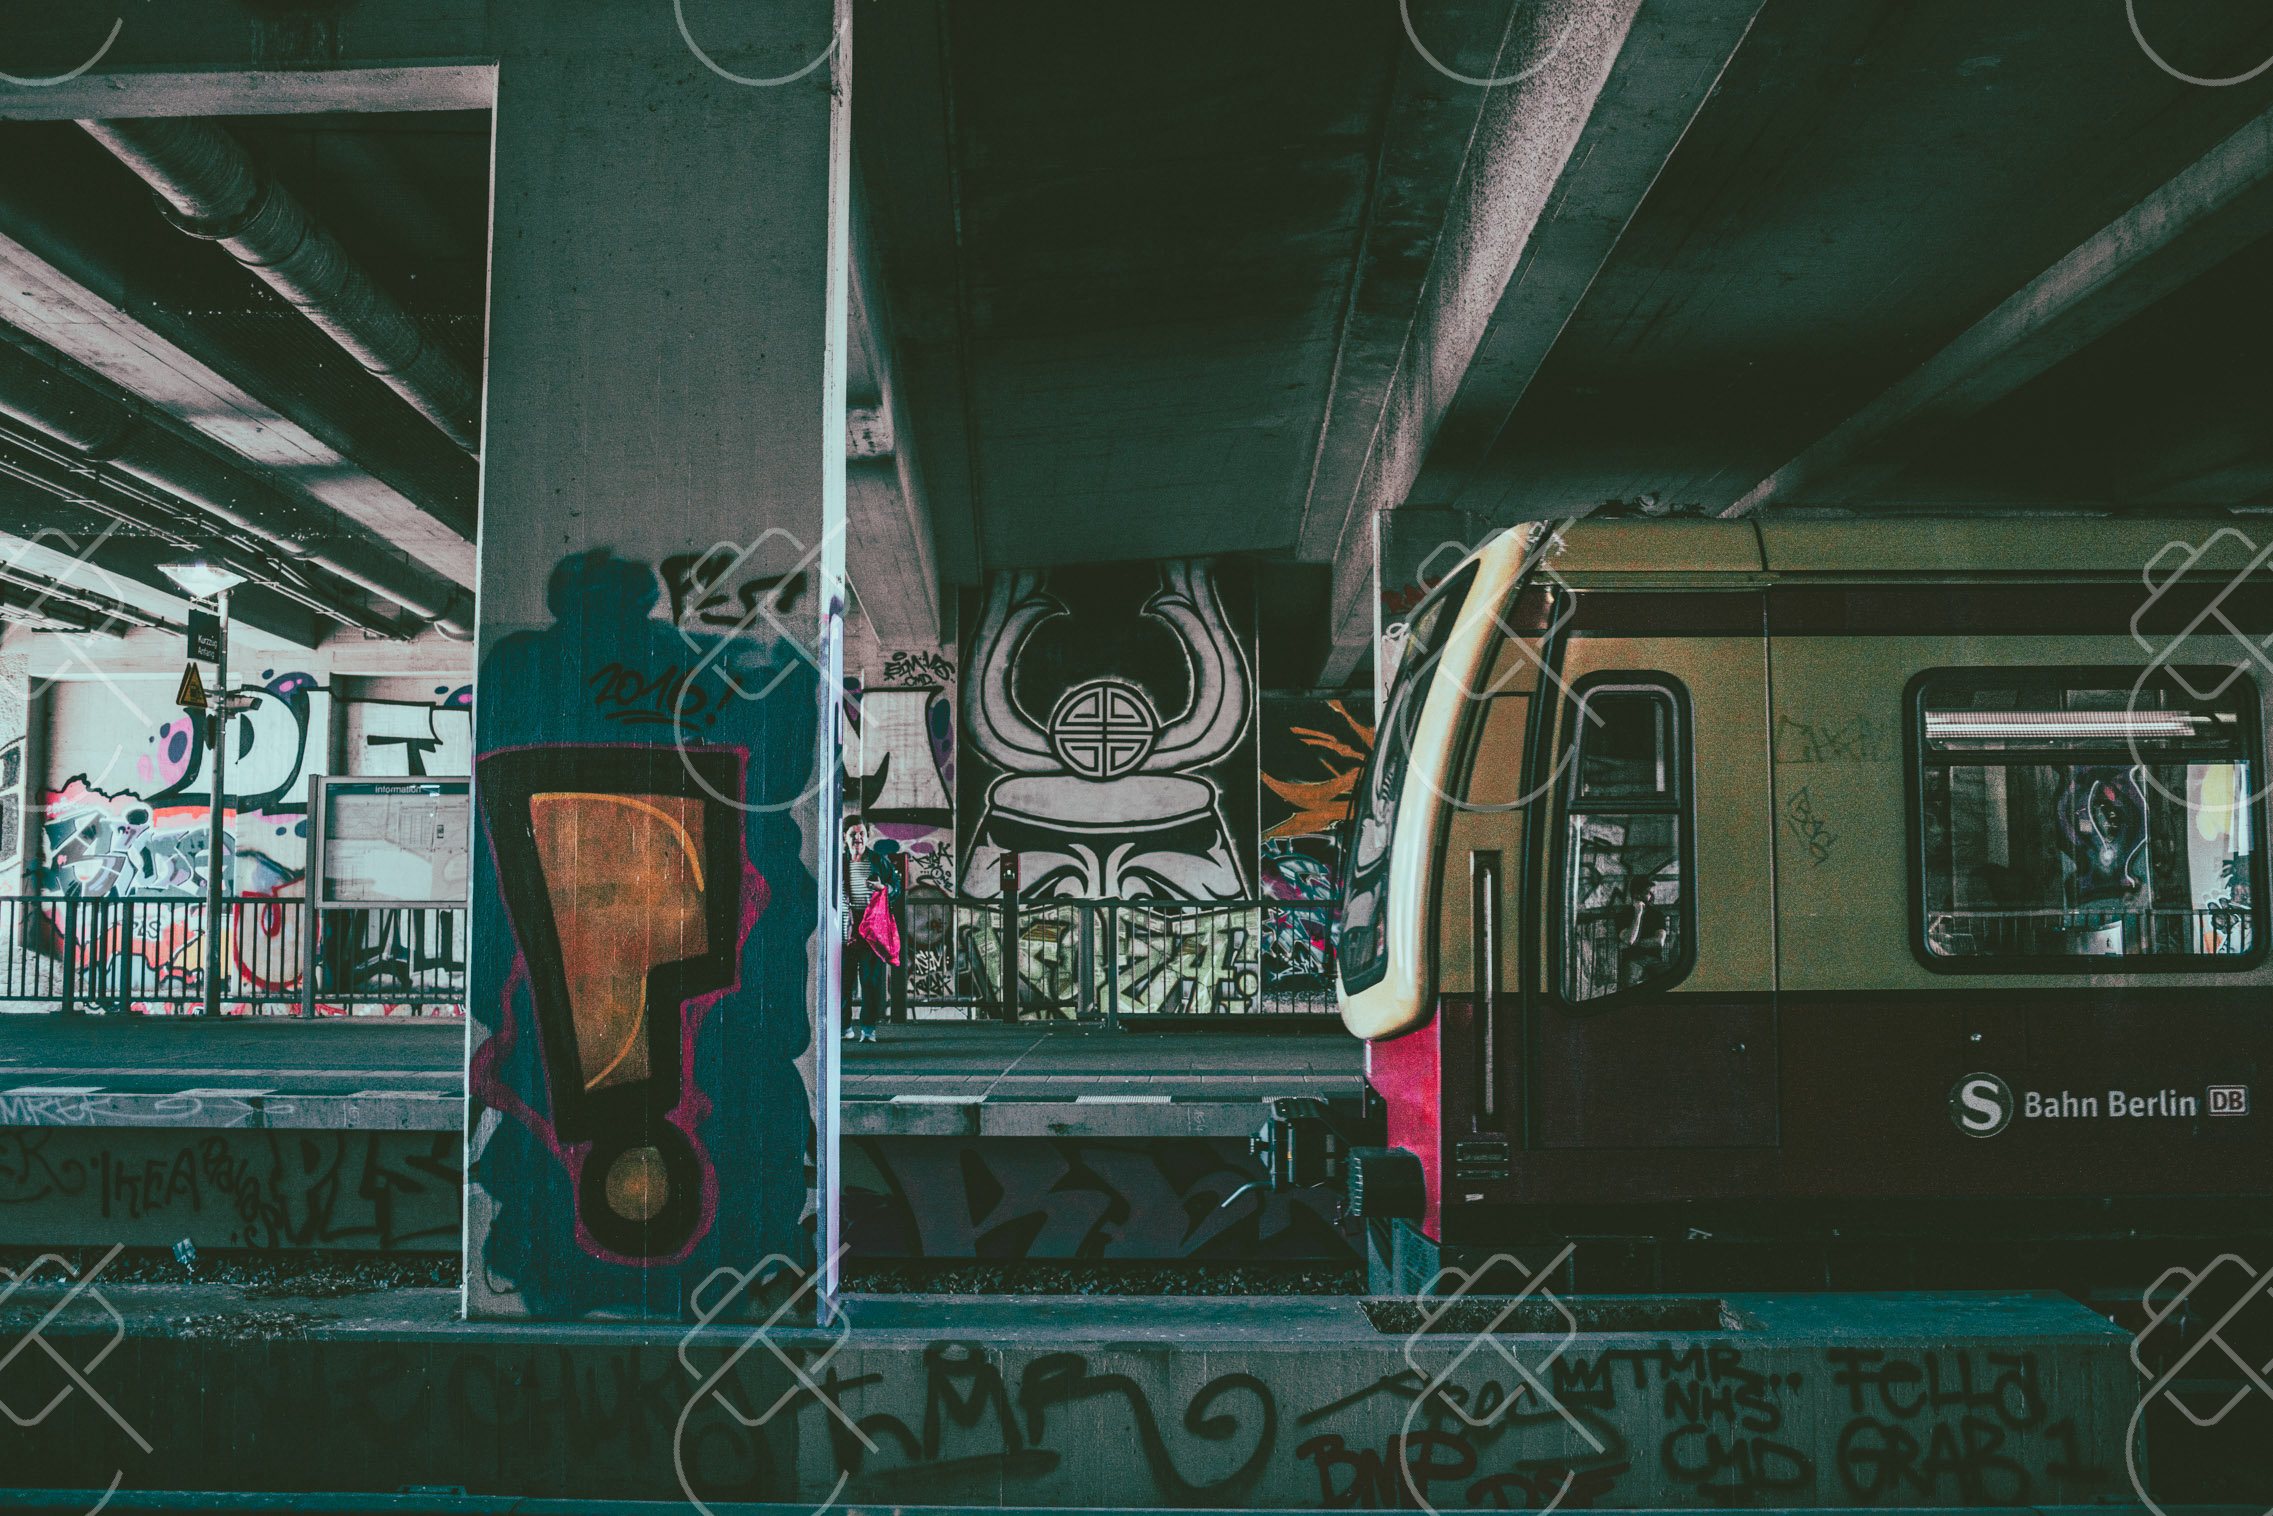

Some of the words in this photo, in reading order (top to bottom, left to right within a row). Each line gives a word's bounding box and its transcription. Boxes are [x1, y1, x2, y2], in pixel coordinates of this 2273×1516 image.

[375, 785, 422, 794] Information
[1960, 1079, 2003, 1131] S
[2024, 1090, 2098, 1118] Bahn
[2108, 1089, 2197, 1118] Berlin
[2210, 1088, 2246, 1113] DB
